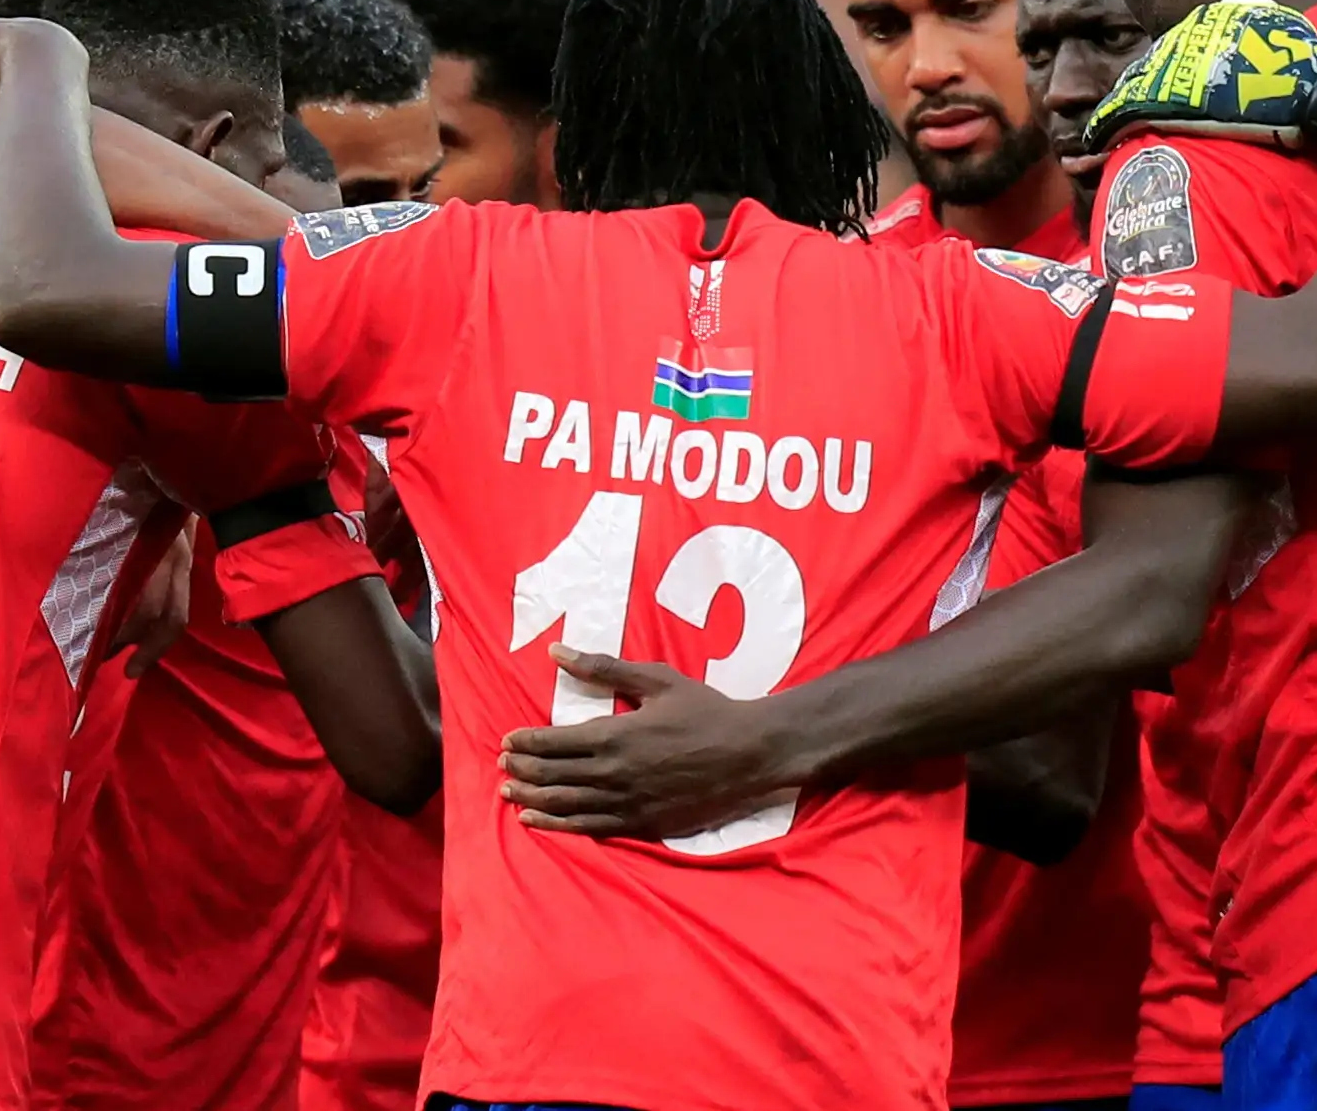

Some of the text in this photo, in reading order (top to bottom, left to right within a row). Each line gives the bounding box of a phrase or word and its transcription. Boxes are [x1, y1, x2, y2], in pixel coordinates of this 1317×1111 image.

[1108, 195, 1183, 236] Celebrate
[188, 244, 266, 297] C
[1121, 244, 1174, 273] CAF
[503, 390, 873, 514] PA MODOU
[509, 490, 807, 856] 13
